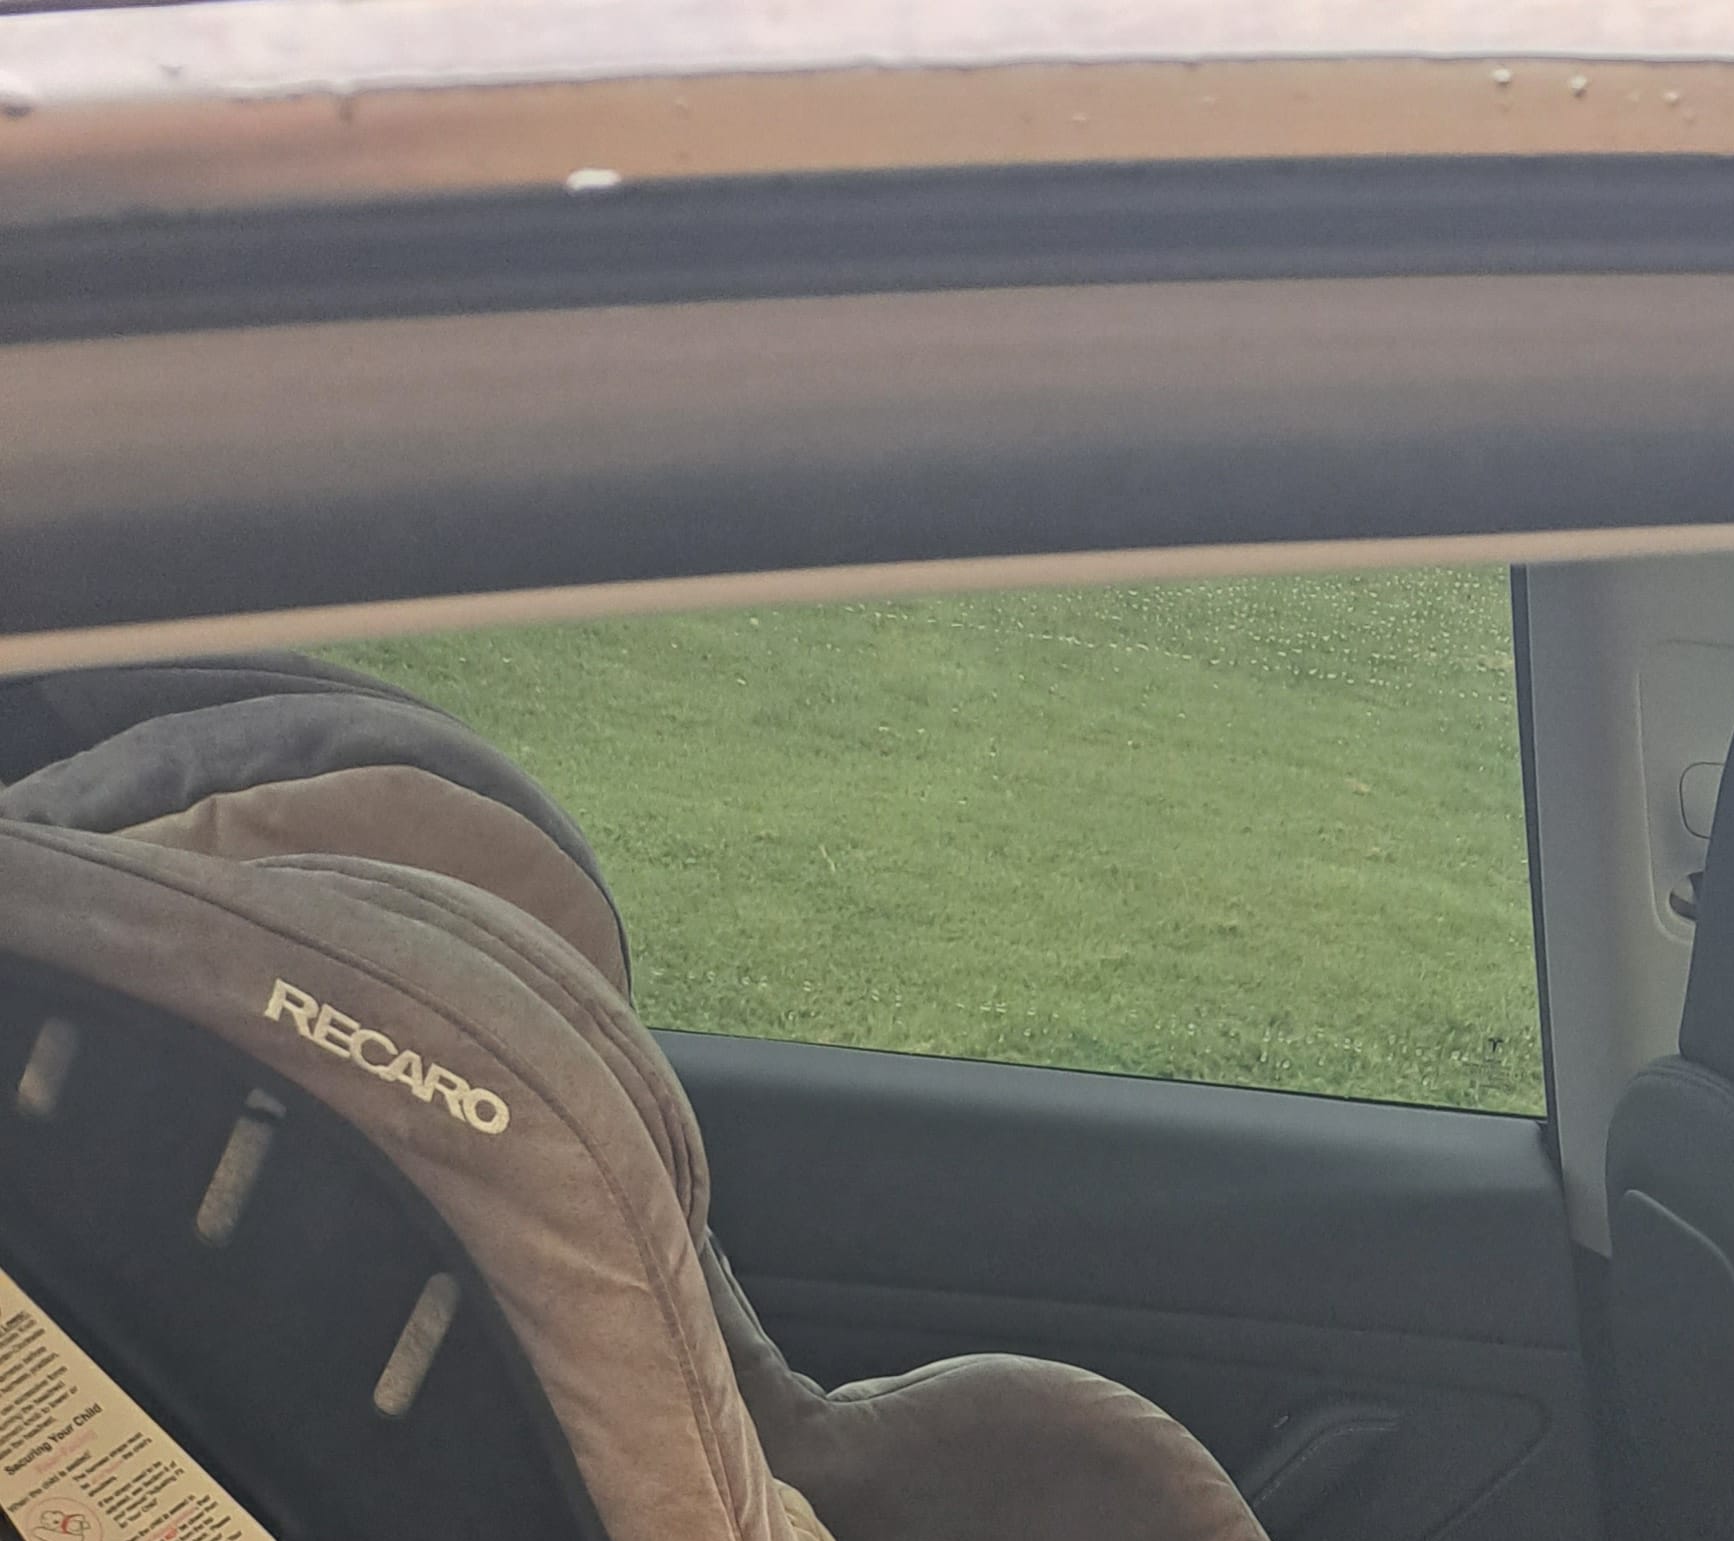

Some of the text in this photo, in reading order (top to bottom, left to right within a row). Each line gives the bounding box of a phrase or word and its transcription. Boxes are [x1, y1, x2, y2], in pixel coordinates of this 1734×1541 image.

[264, 978, 511, 1134] RECARO
[3, 1439, 53, 1477] Securing
[47, 1421, 76, 1446] Your
[71, 1401, 103, 1428] Child
